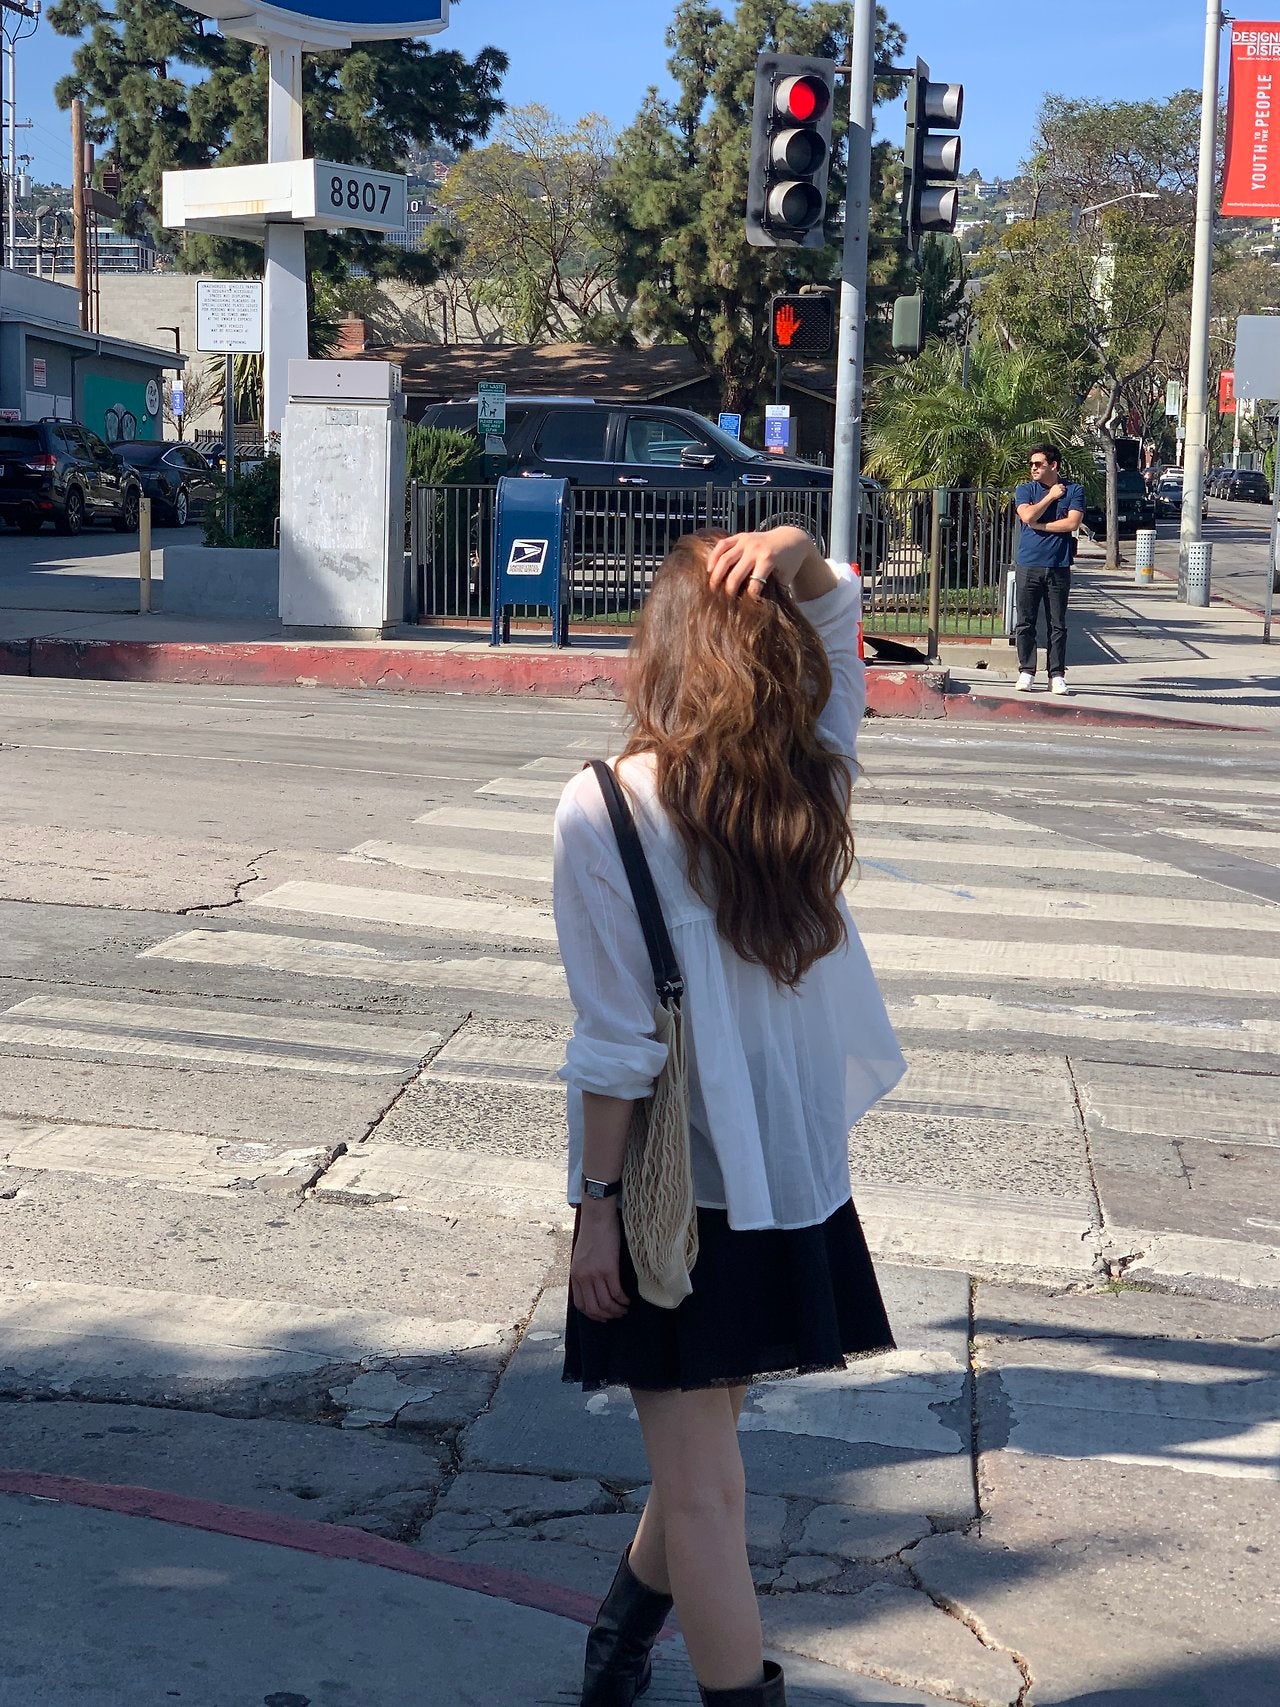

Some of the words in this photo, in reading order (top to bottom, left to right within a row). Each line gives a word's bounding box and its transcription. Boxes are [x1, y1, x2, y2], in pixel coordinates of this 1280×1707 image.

[1232, 31, 1280, 43] DESIGN
[1255, 74, 1272, 128] PEOPLE
[1254, 131, 1261, 140] TO
[1251, 144, 1268, 190] YOUTH
[330, 176, 392, 214] 8807
